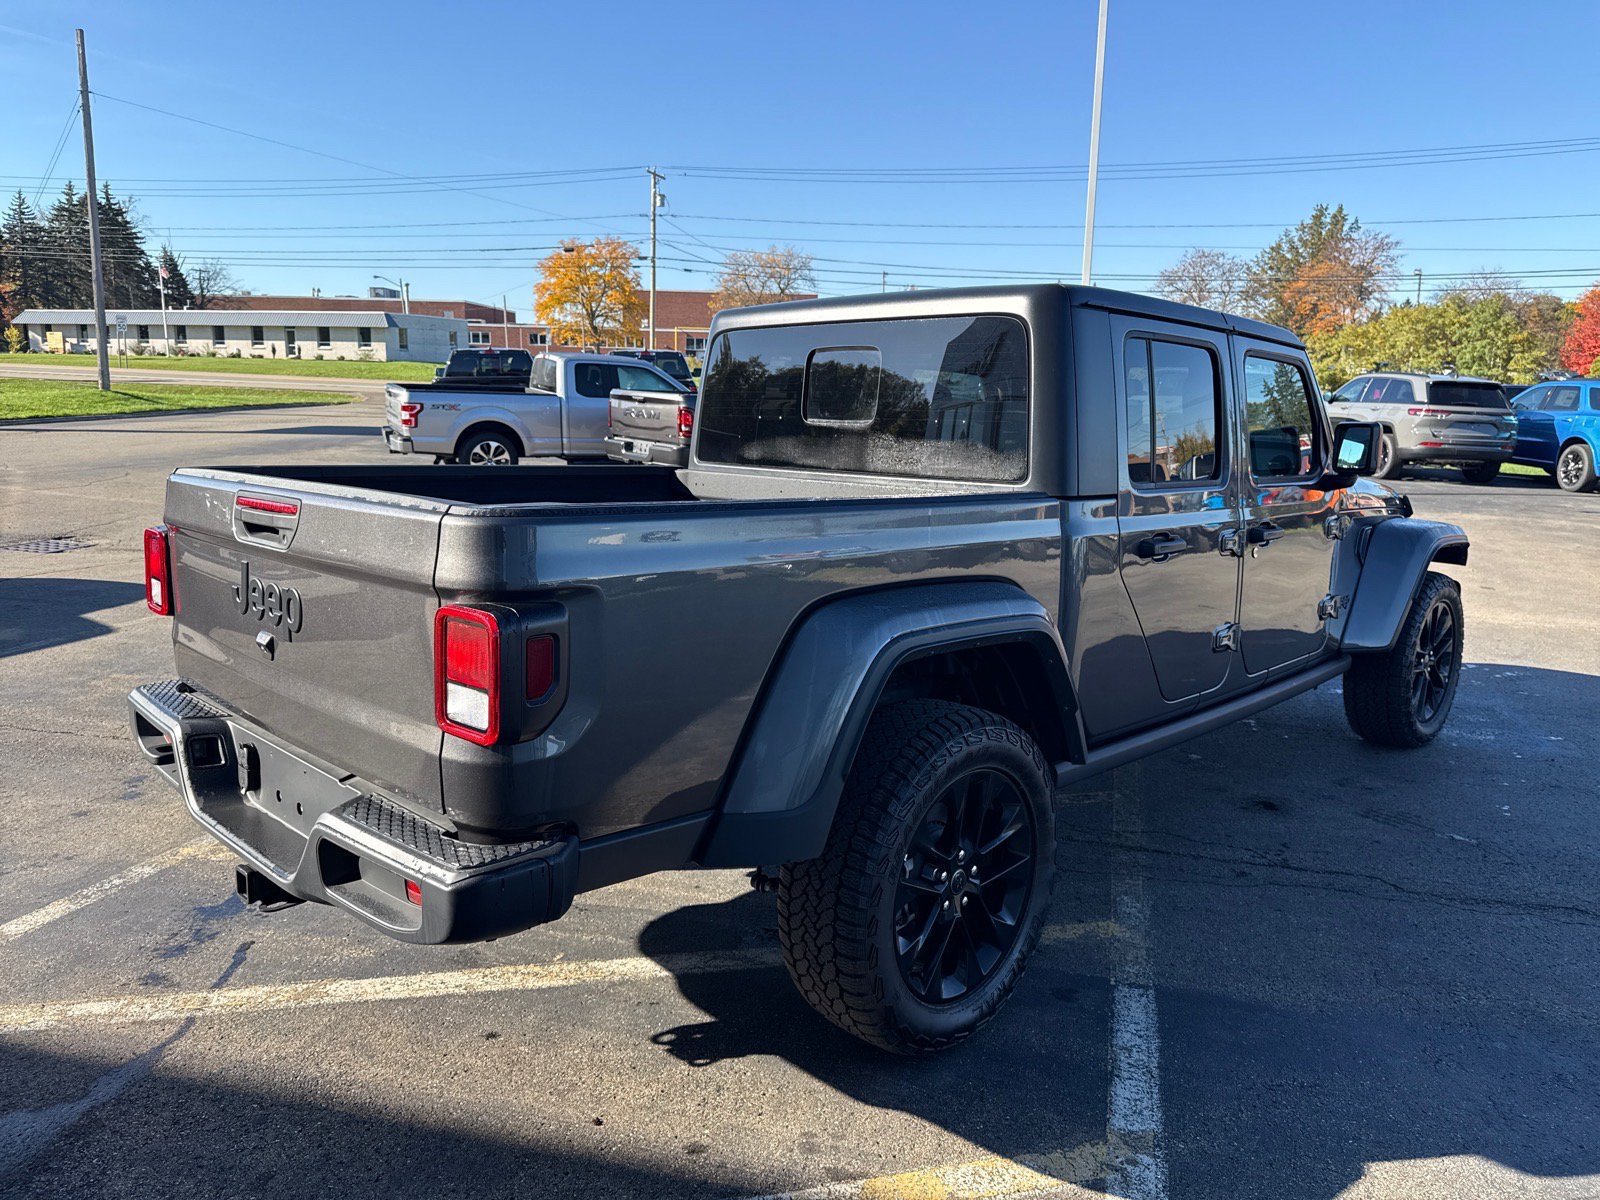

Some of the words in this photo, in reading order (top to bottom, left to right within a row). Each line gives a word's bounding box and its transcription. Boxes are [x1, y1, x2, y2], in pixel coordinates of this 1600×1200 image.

[430, 403, 462, 411] STX
[624, 408, 661, 420] RAM
[231, 560, 303, 643] Jeep
